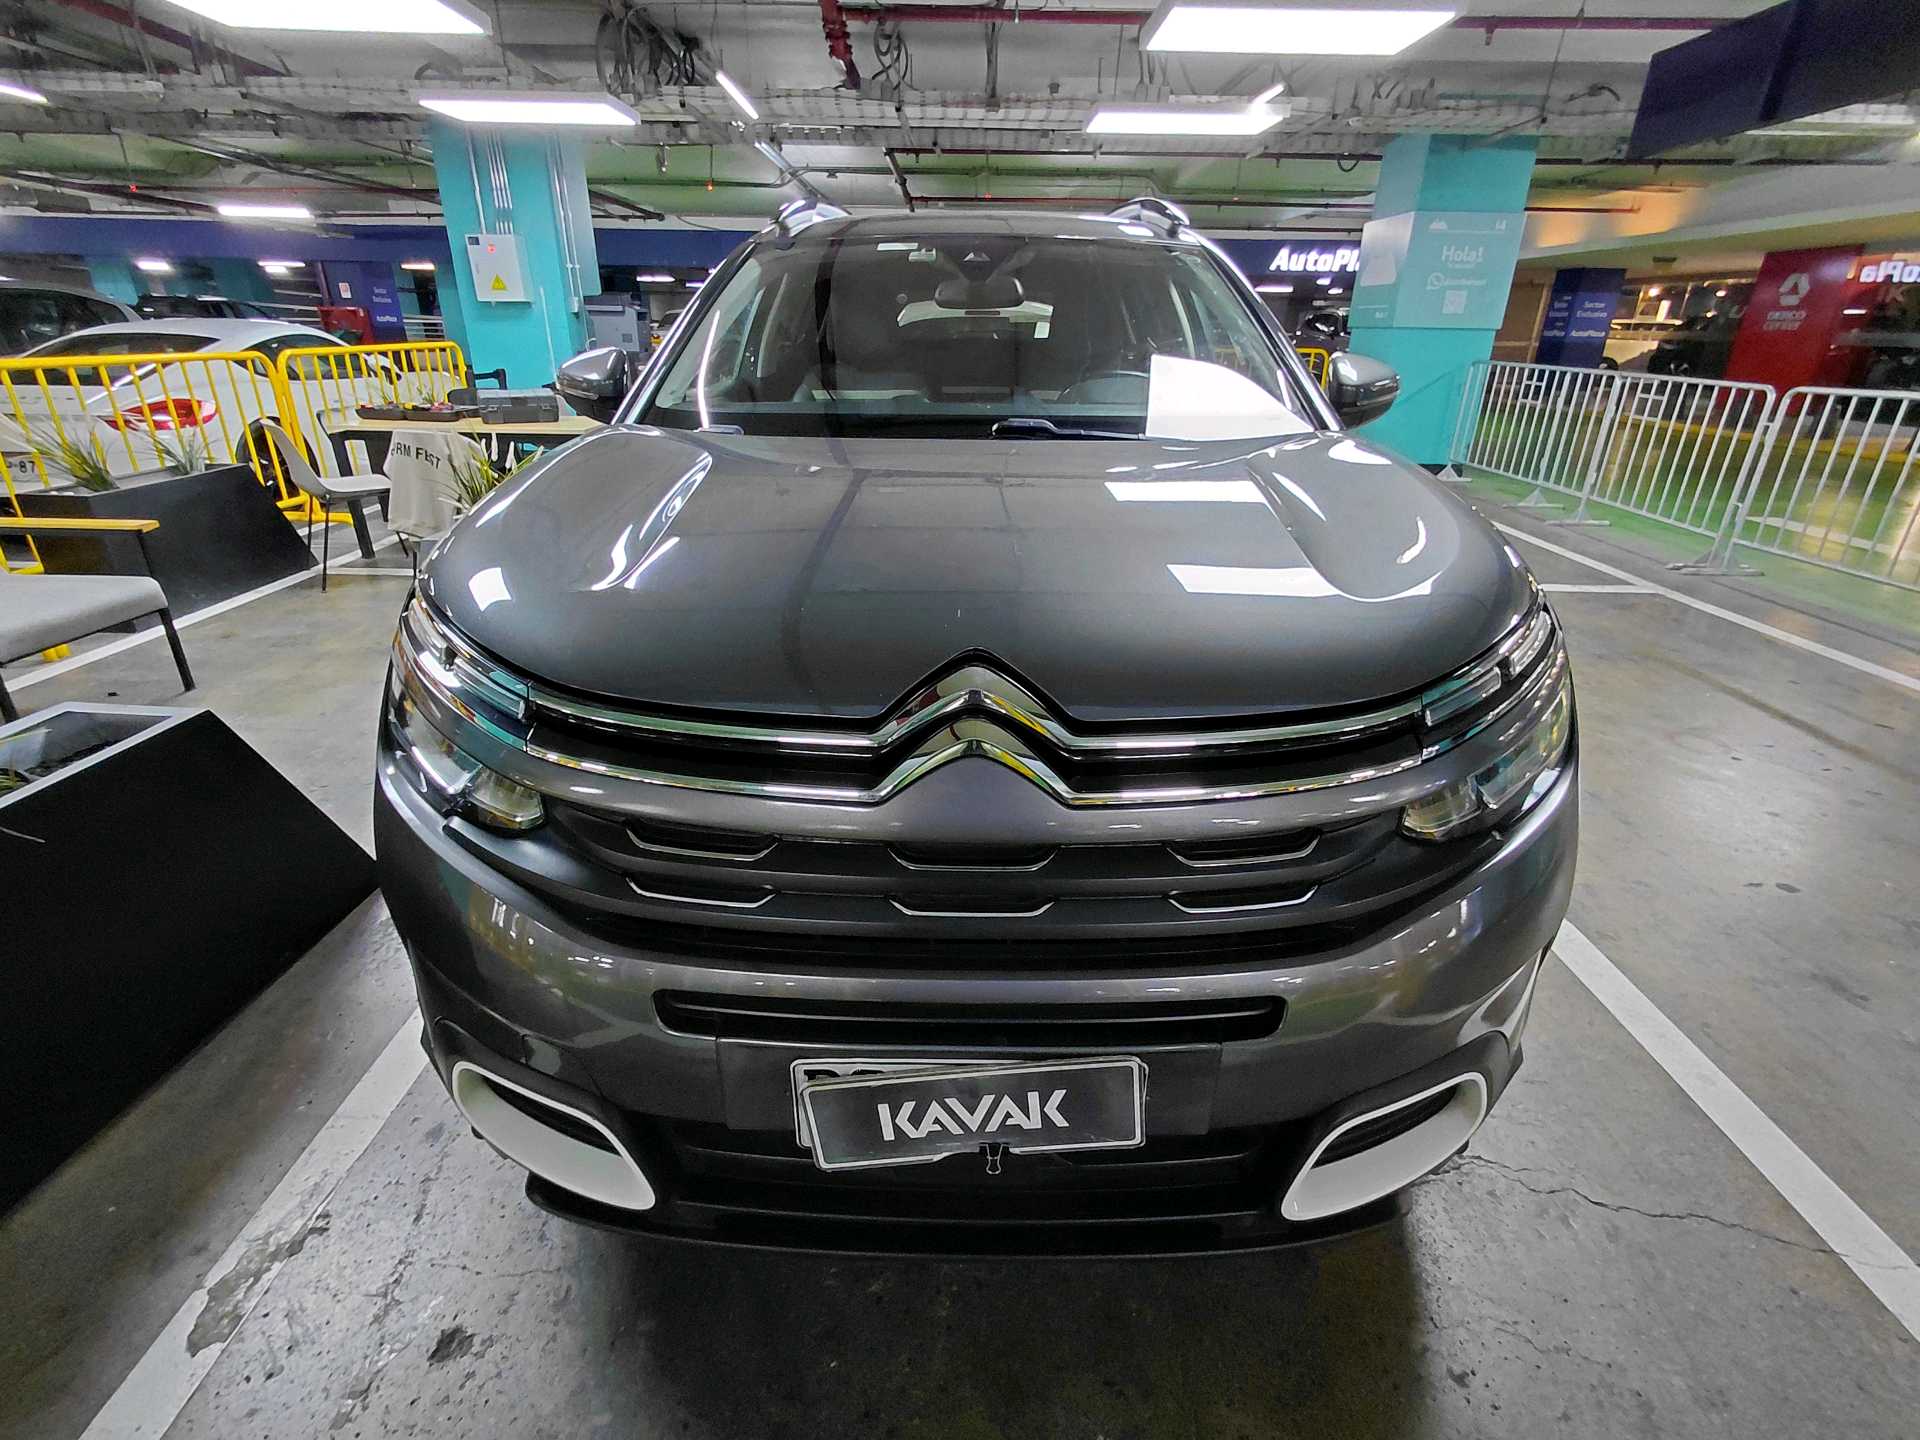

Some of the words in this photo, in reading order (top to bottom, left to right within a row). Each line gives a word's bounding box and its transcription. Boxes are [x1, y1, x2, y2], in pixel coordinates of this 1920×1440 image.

[1269, 248, 1360, 272] AutoPl
[1442, 246, 1483, 263] Hola!
[877, 1088, 1070, 1142] KAVAK
